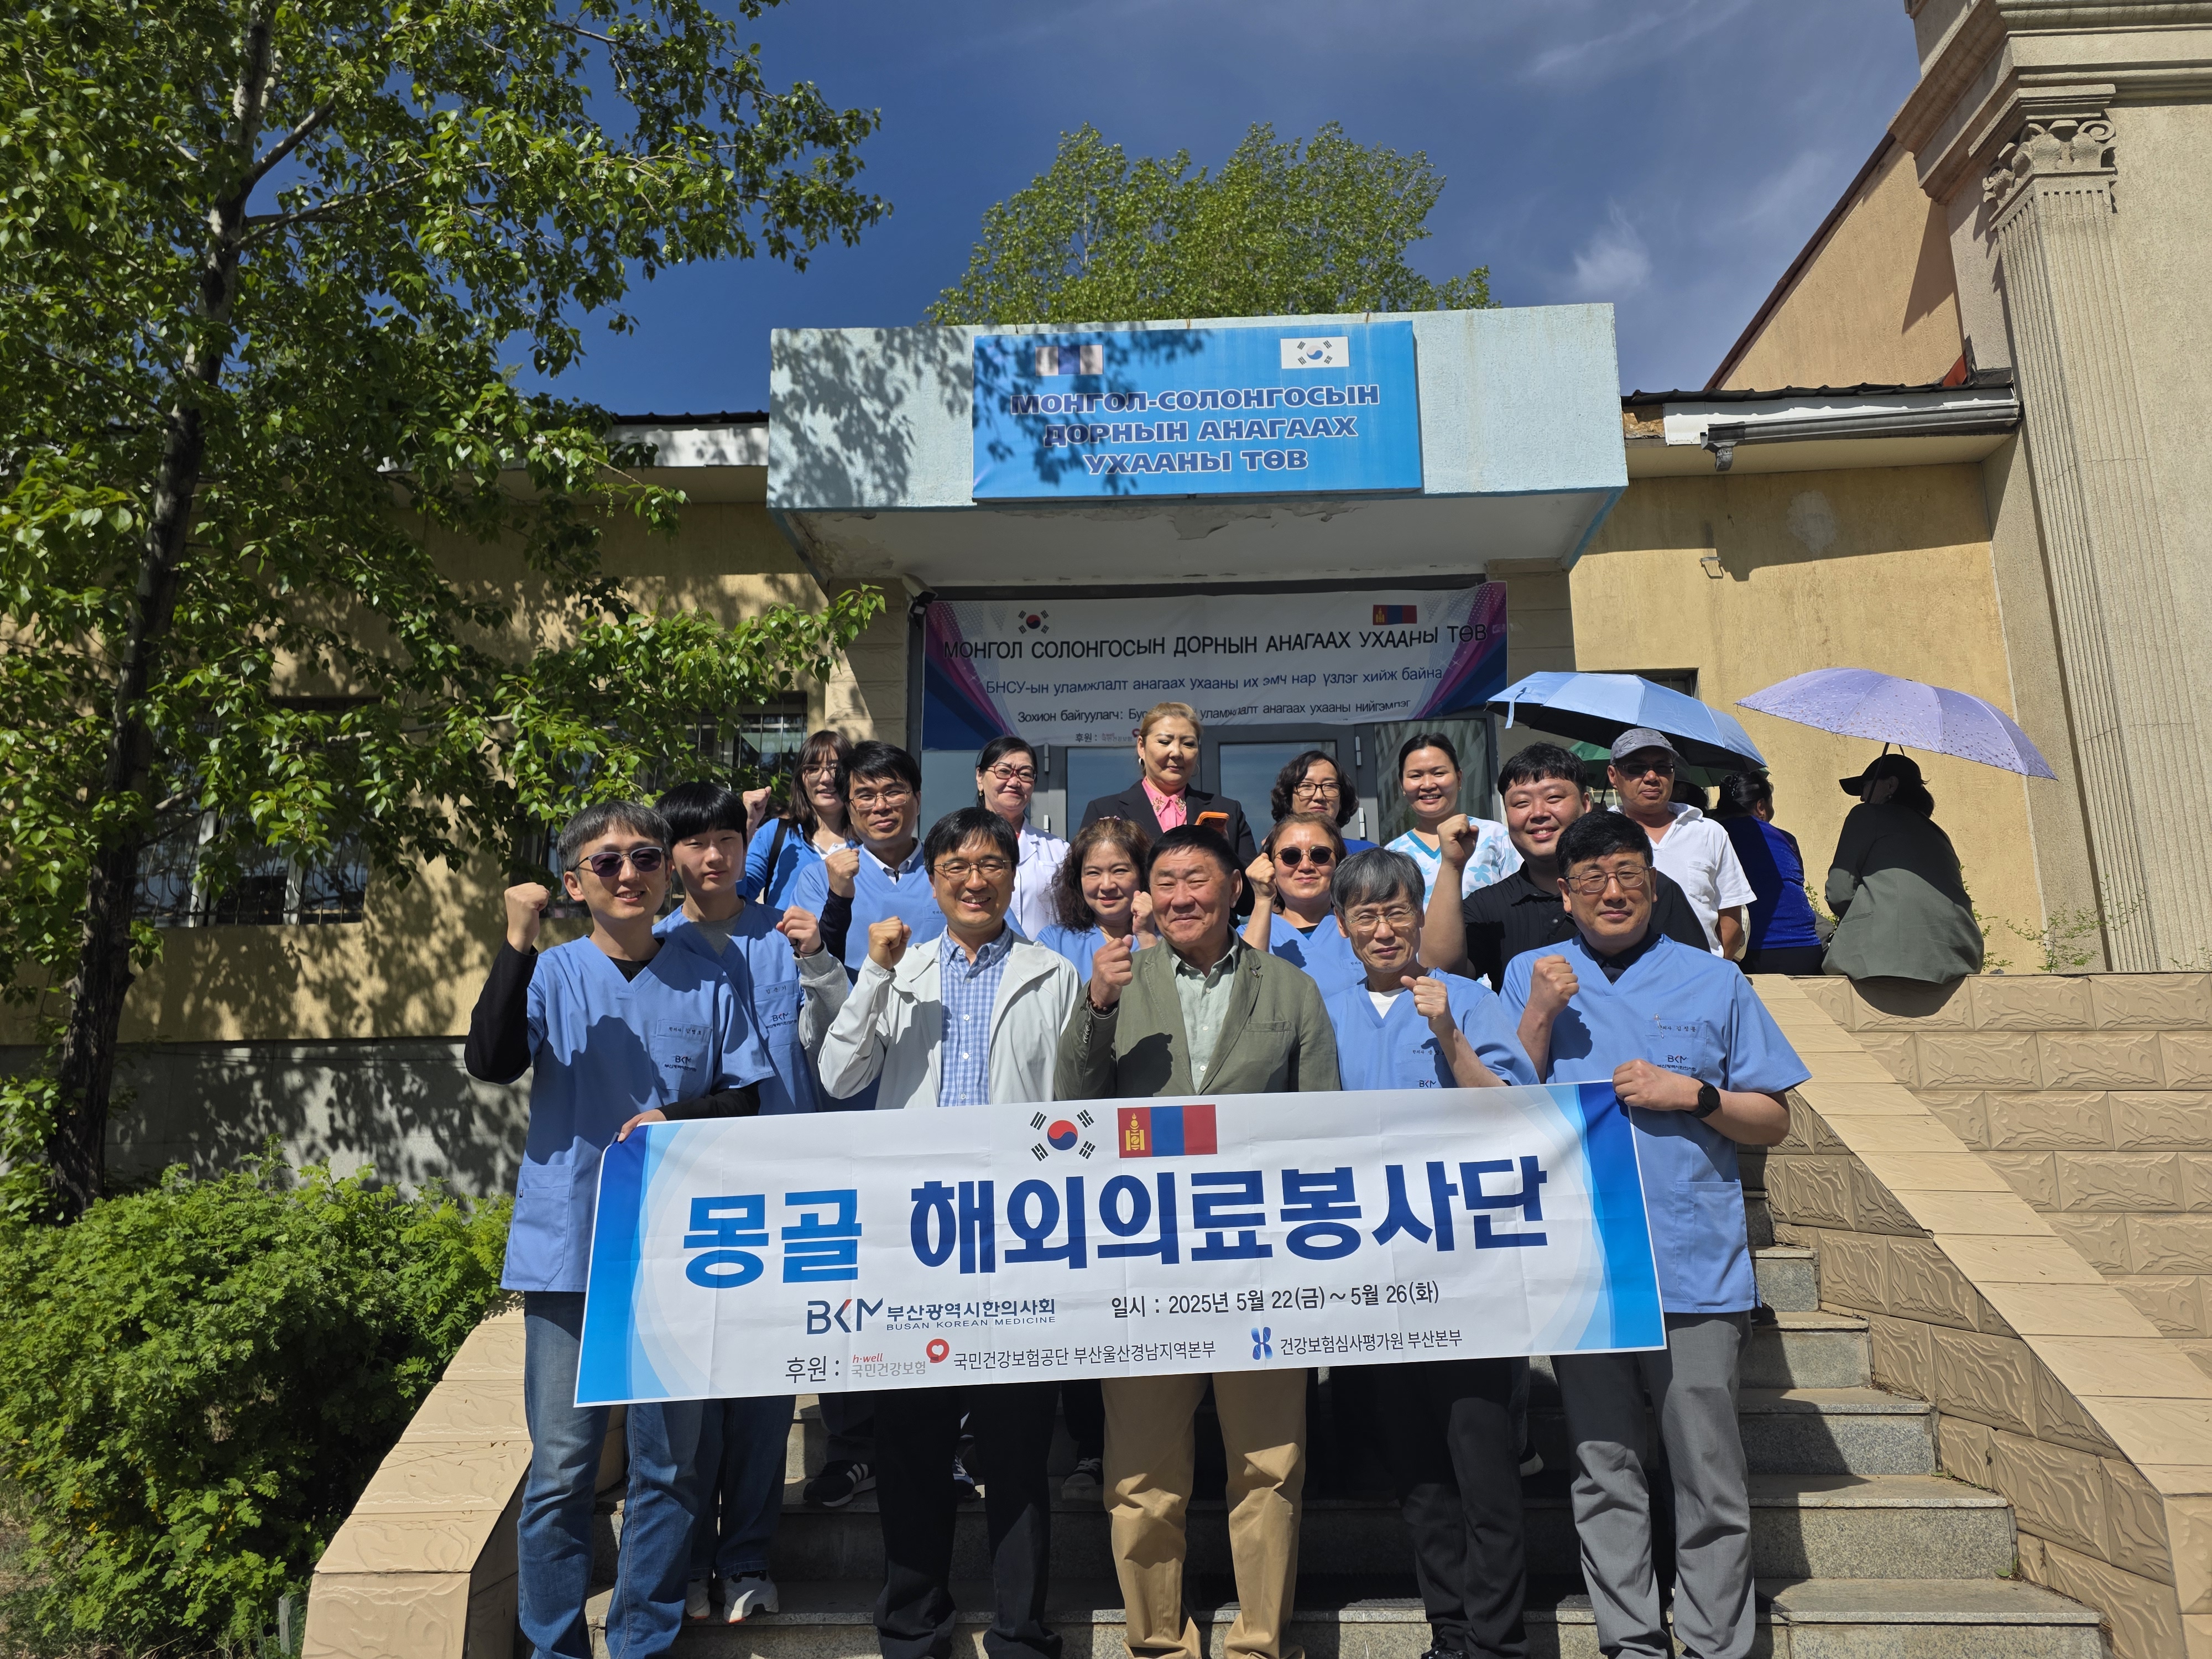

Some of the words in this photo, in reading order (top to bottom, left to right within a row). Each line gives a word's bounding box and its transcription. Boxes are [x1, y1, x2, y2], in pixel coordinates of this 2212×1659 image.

[1010, 384, 1380, 414] МОНГОЛ-СОЛОНГОСЫН
[1044, 421, 1188, 447] ДОРНЫН
[1197, 416, 1358, 441] АНАГААХ
[1082, 451, 1232, 474] УХААНЫ
[1240, 449, 1308, 471] ТӨВ
[945, 641, 1022, 659] МОНГОЛ
[1031, 637, 1165, 659] СОЛОНГОСЫН
[1173, 636, 1257, 657] ДОРНЫН
[1265, 632, 1351, 653] АНАГААХ
[1359, 627, 1438, 648] УХААНЫ
[1447, 624, 1486, 643] ТӨВ
[986, 681, 1048, 693] БНСУ-ын
[1053, 680, 1129, 696] уламжлалт
[1133, 678, 1186, 690] анагаах
[1190, 677, 1238, 690] ухааны
[1244, 677, 1259, 688] их
[1263, 674, 1287, 686] эмч
[1292, 673, 1316, 686] нар
[1323, 673, 1358, 687] үзлэг
[1363, 669, 1398, 683] хийж
[1402, 666, 1442, 680] байна
[1018, 711, 1056, 723] Зохион
[1263, 704, 1306, 714] анагаах
[1310, 703, 1350, 716] ухааны
[1075, 733, 1092, 743] 후원
[1667, 1055, 1688, 1063] BKM
[683, 1189, 862, 1288] 몽골
[910, 1155, 1548, 1275] 해외의료봉사단
[887, 1298, 1055, 1322] 부산광역시한의사회
[1112, 1296, 1146, 1318] 일시
[1168, 1292, 1229, 1314] 2025년
[1237, 1290, 1265, 1312] 5월
[1386, 1280, 1439, 1305] 26(화)
[807, 1297, 883, 1335] BKM
[886, 1322, 929, 1331] BUSAN
[937, 1319, 988, 1328] KOREAN
[995, 1316, 1056, 1326] MEDICINE
[954, 1348, 1069, 1370] 국민건강보험공단
[1073, 1341, 1216, 1365] 부산울산경남지역본부
[1280, 1332, 1404, 1355] 건강보험심사평가원
[1408, 1329, 1463, 1349] 부산본부
[785, 1356, 826, 1384] 후원
[851, 1361, 926, 1378] 국민건강보험
